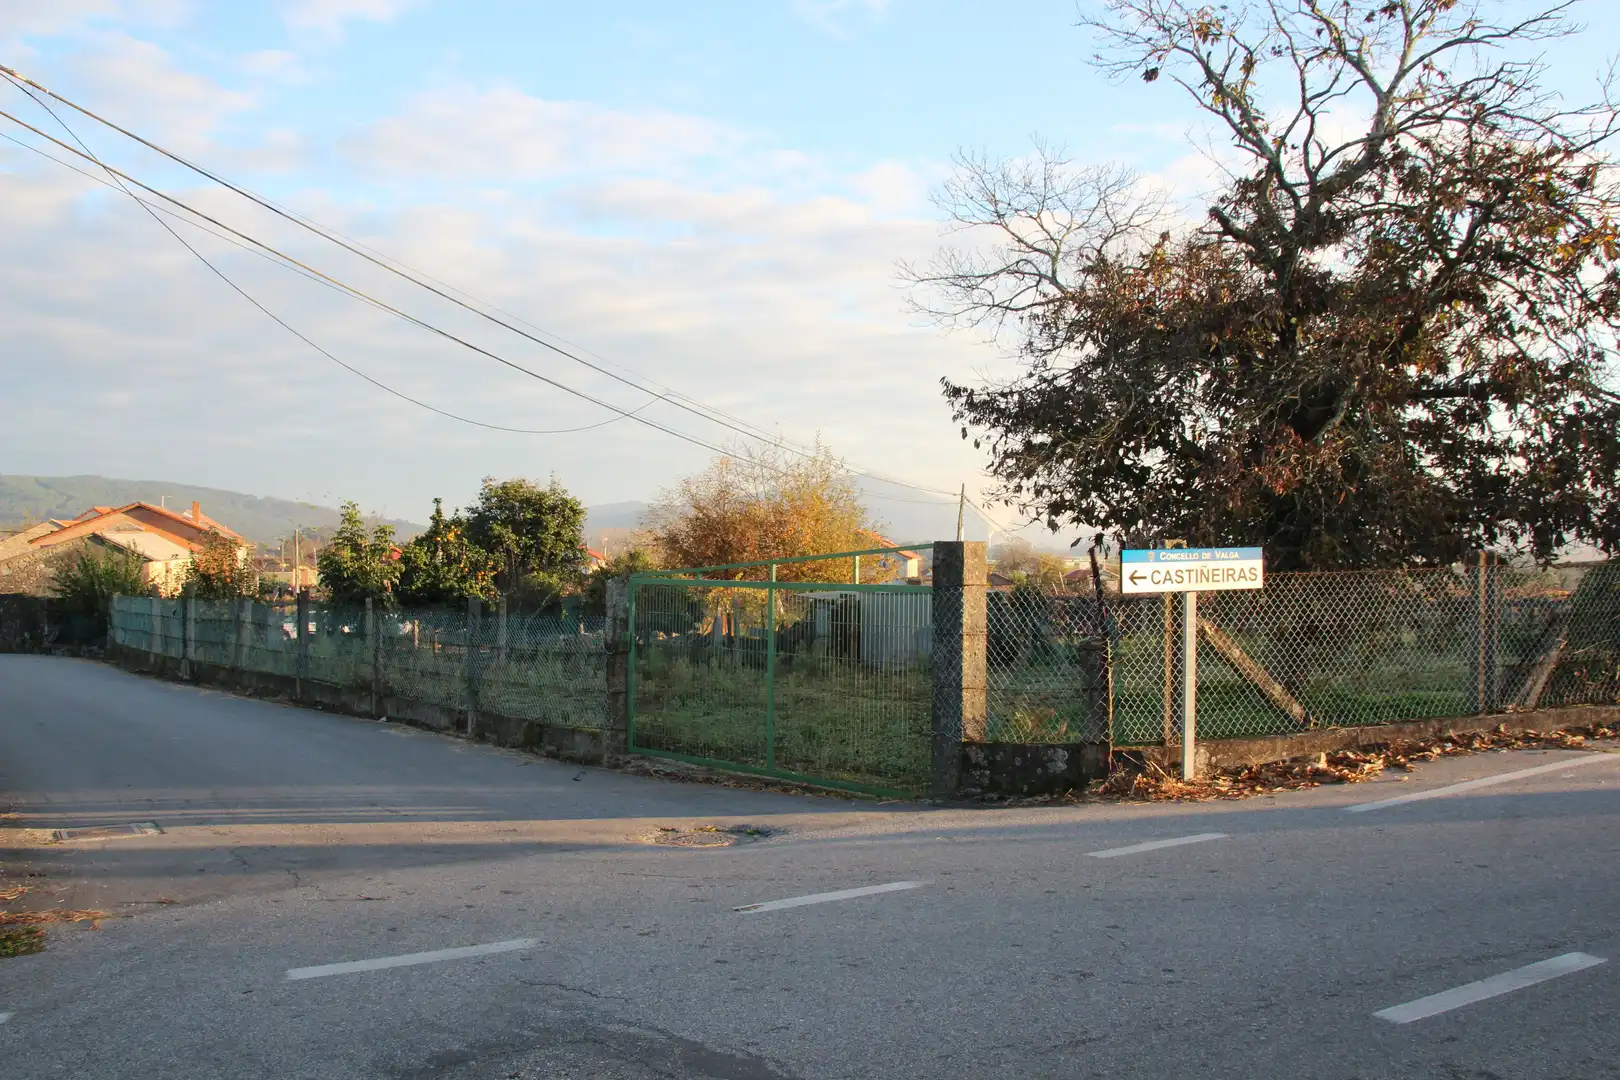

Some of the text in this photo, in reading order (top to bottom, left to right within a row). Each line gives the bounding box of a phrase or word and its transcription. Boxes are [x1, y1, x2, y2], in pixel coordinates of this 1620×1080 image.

[1159, 550, 1240, 561] CONCELLO DE VALGA
[1150, 566, 1258, 585] CASTIÑEIRAS
